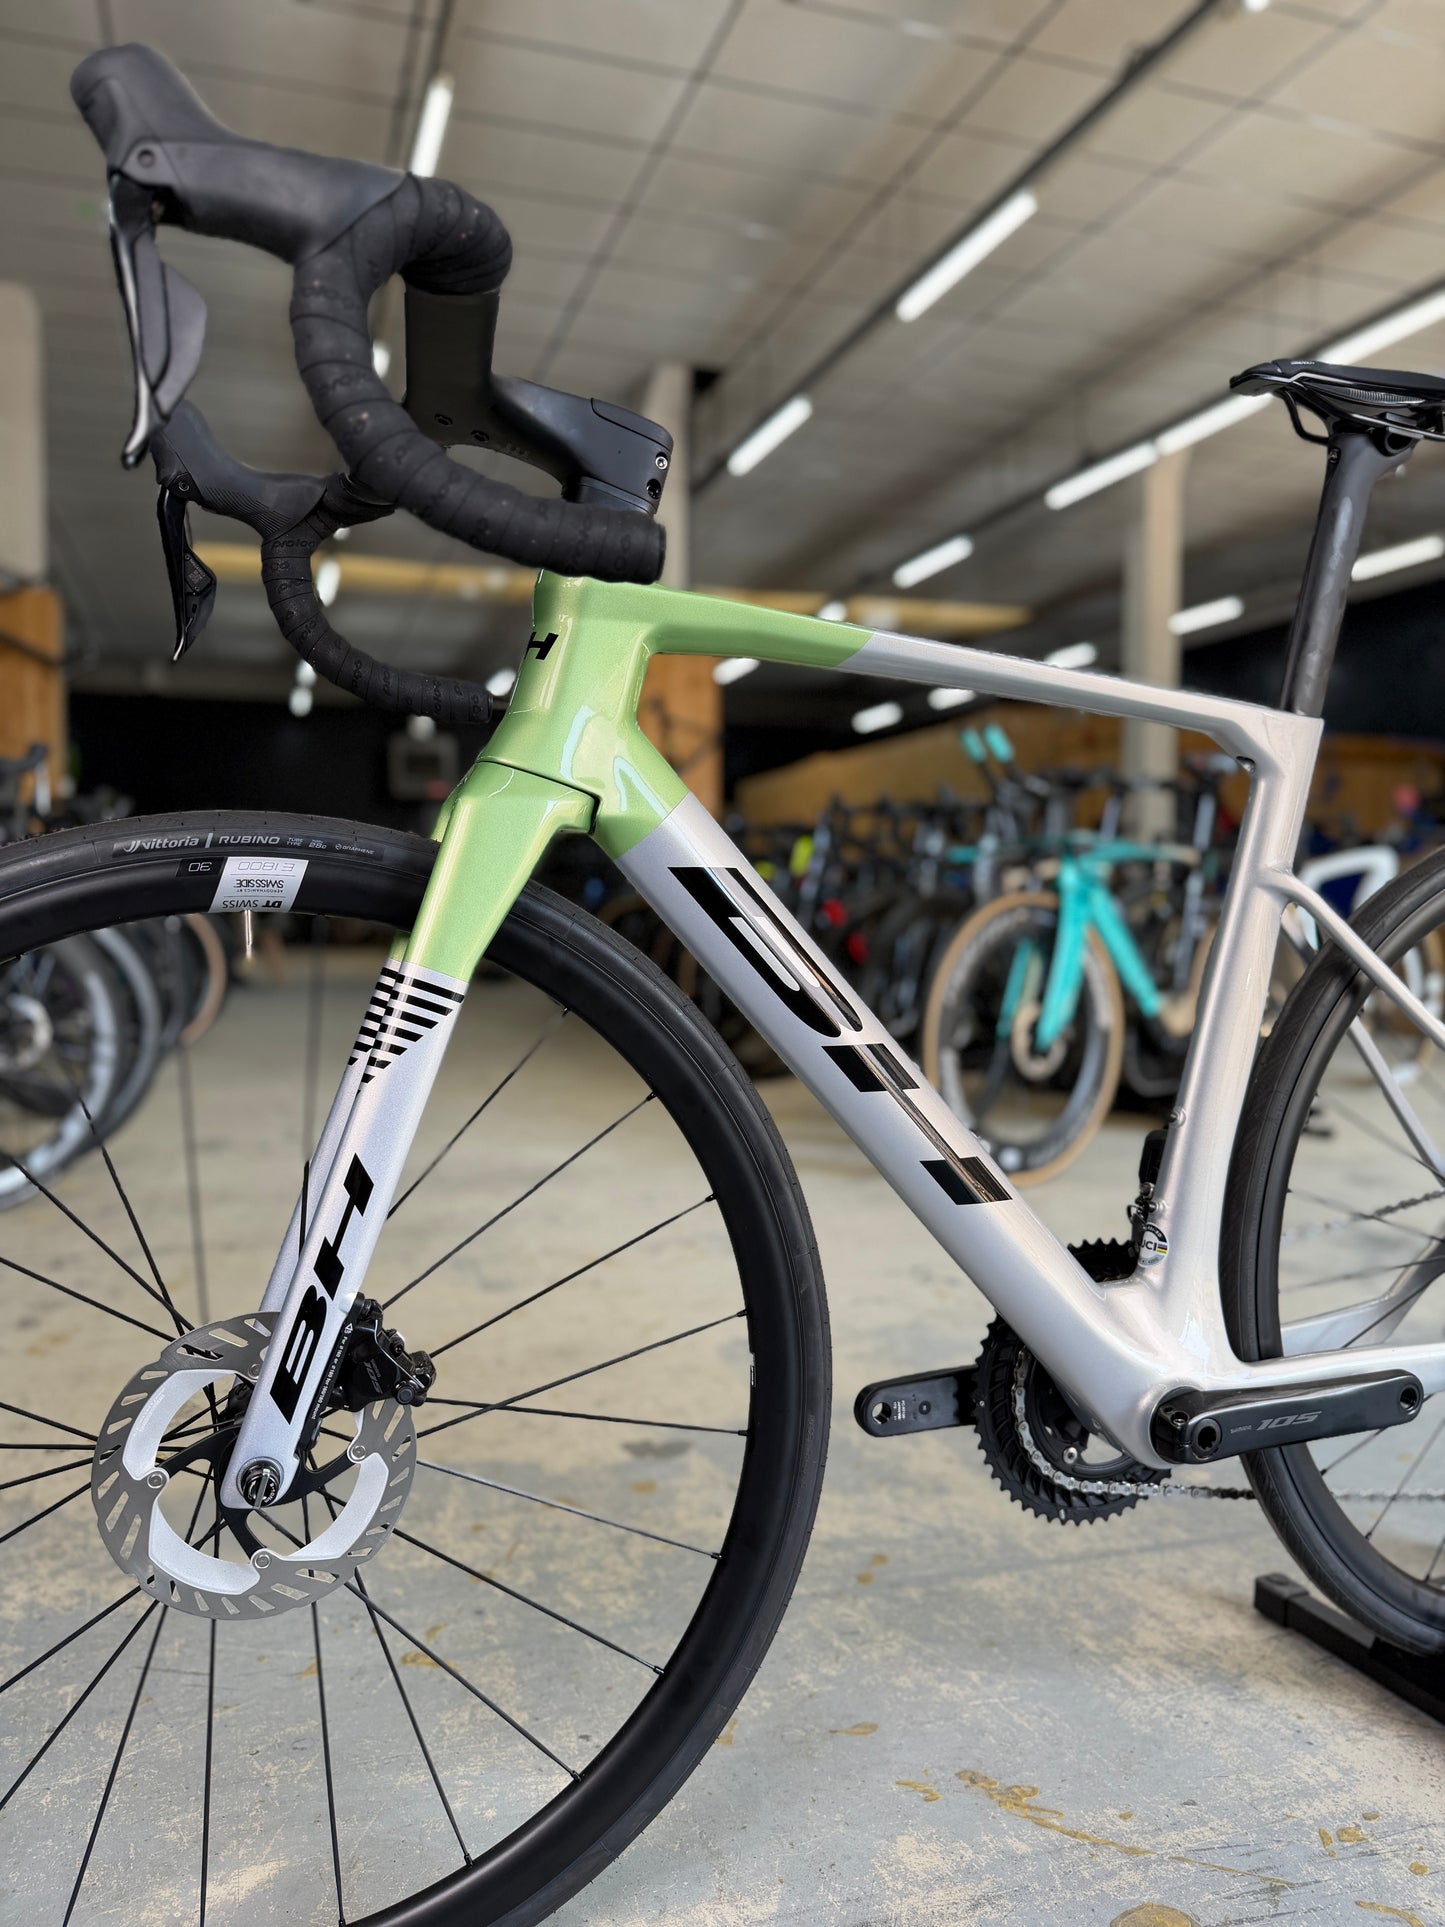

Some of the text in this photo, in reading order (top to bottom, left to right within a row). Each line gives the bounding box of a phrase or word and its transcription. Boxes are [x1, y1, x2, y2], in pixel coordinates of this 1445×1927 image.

[141, 835, 280, 850] vittoria RUBINO
[188, 861, 213, 872] 30
[222, 899, 283, 909] DT SWISS
[667, 867, 1013, 1206] BH
[270, 1152, 374, 1425] BH
[1256, 1410, 1323, 1431] 105
